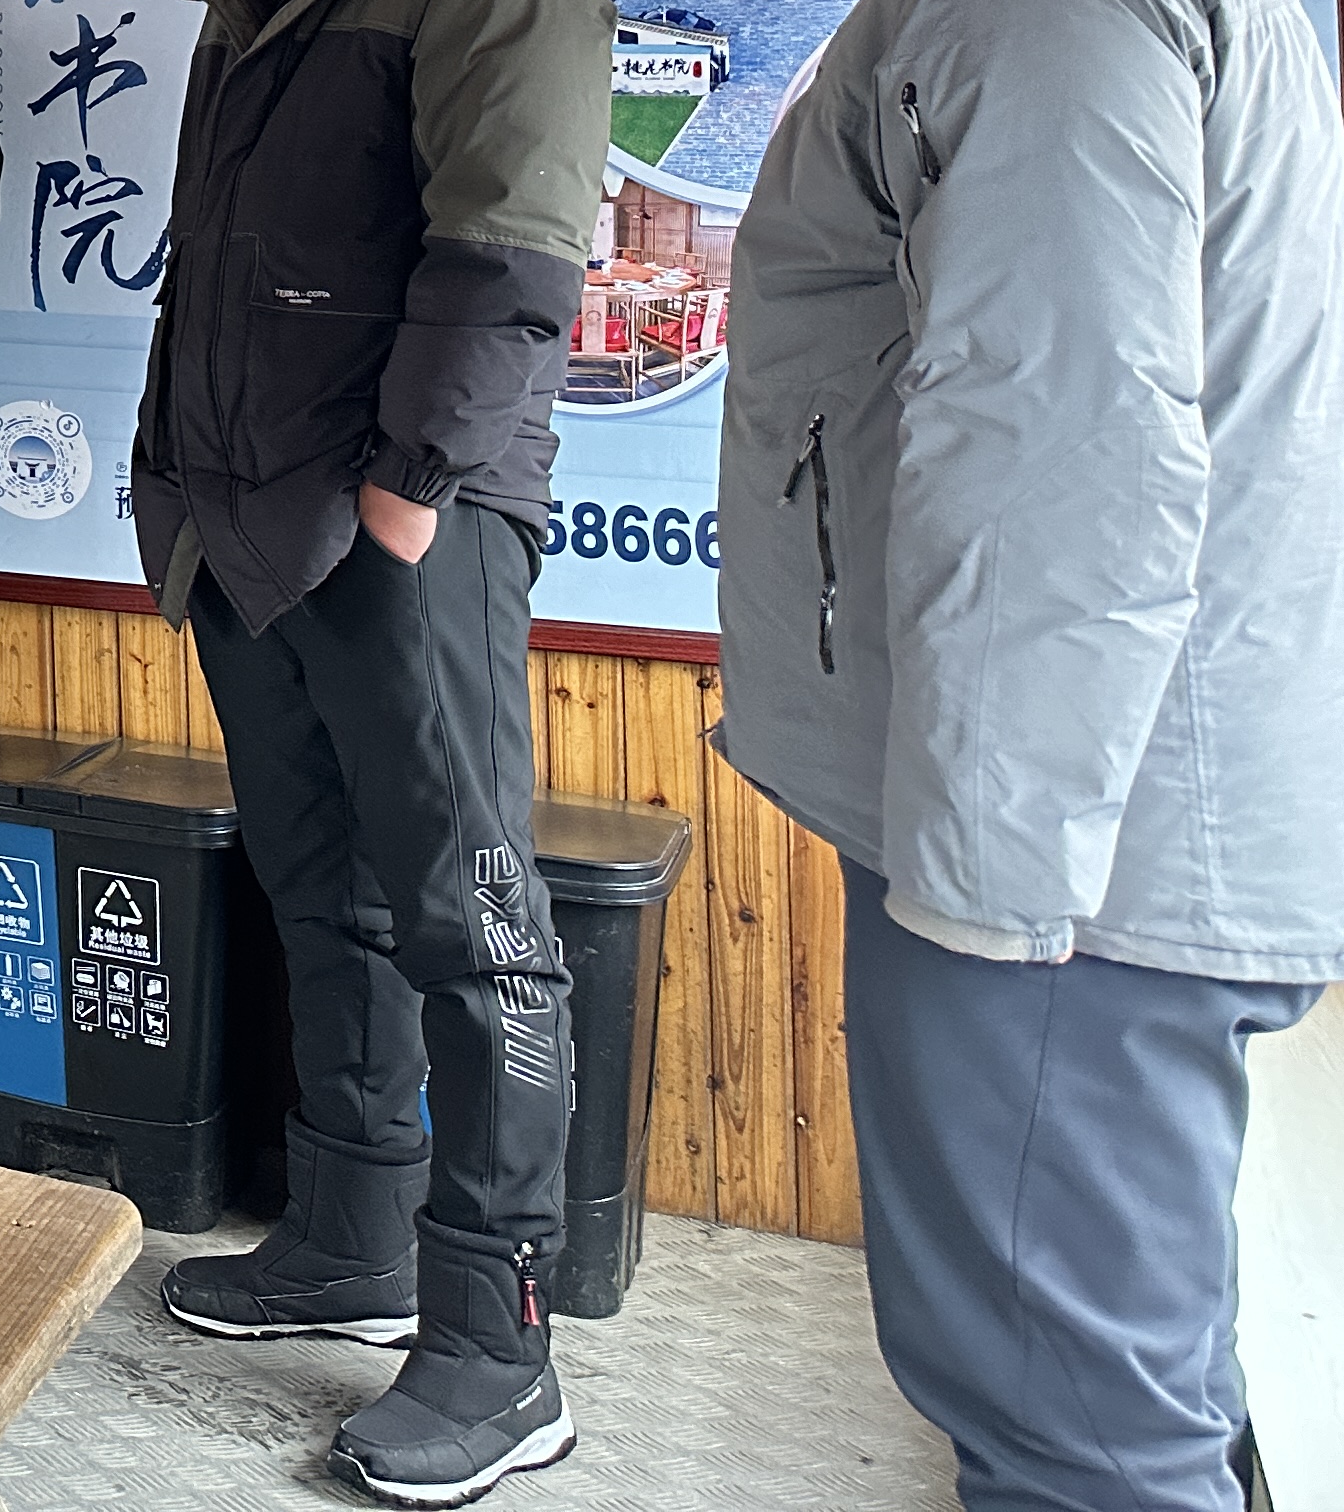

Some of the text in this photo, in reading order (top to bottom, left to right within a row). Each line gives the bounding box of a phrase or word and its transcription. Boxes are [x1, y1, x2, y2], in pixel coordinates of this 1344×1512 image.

[89, 925, 149, 950] 其他垃圾
[88, 940, 151, 959] Residual waste
